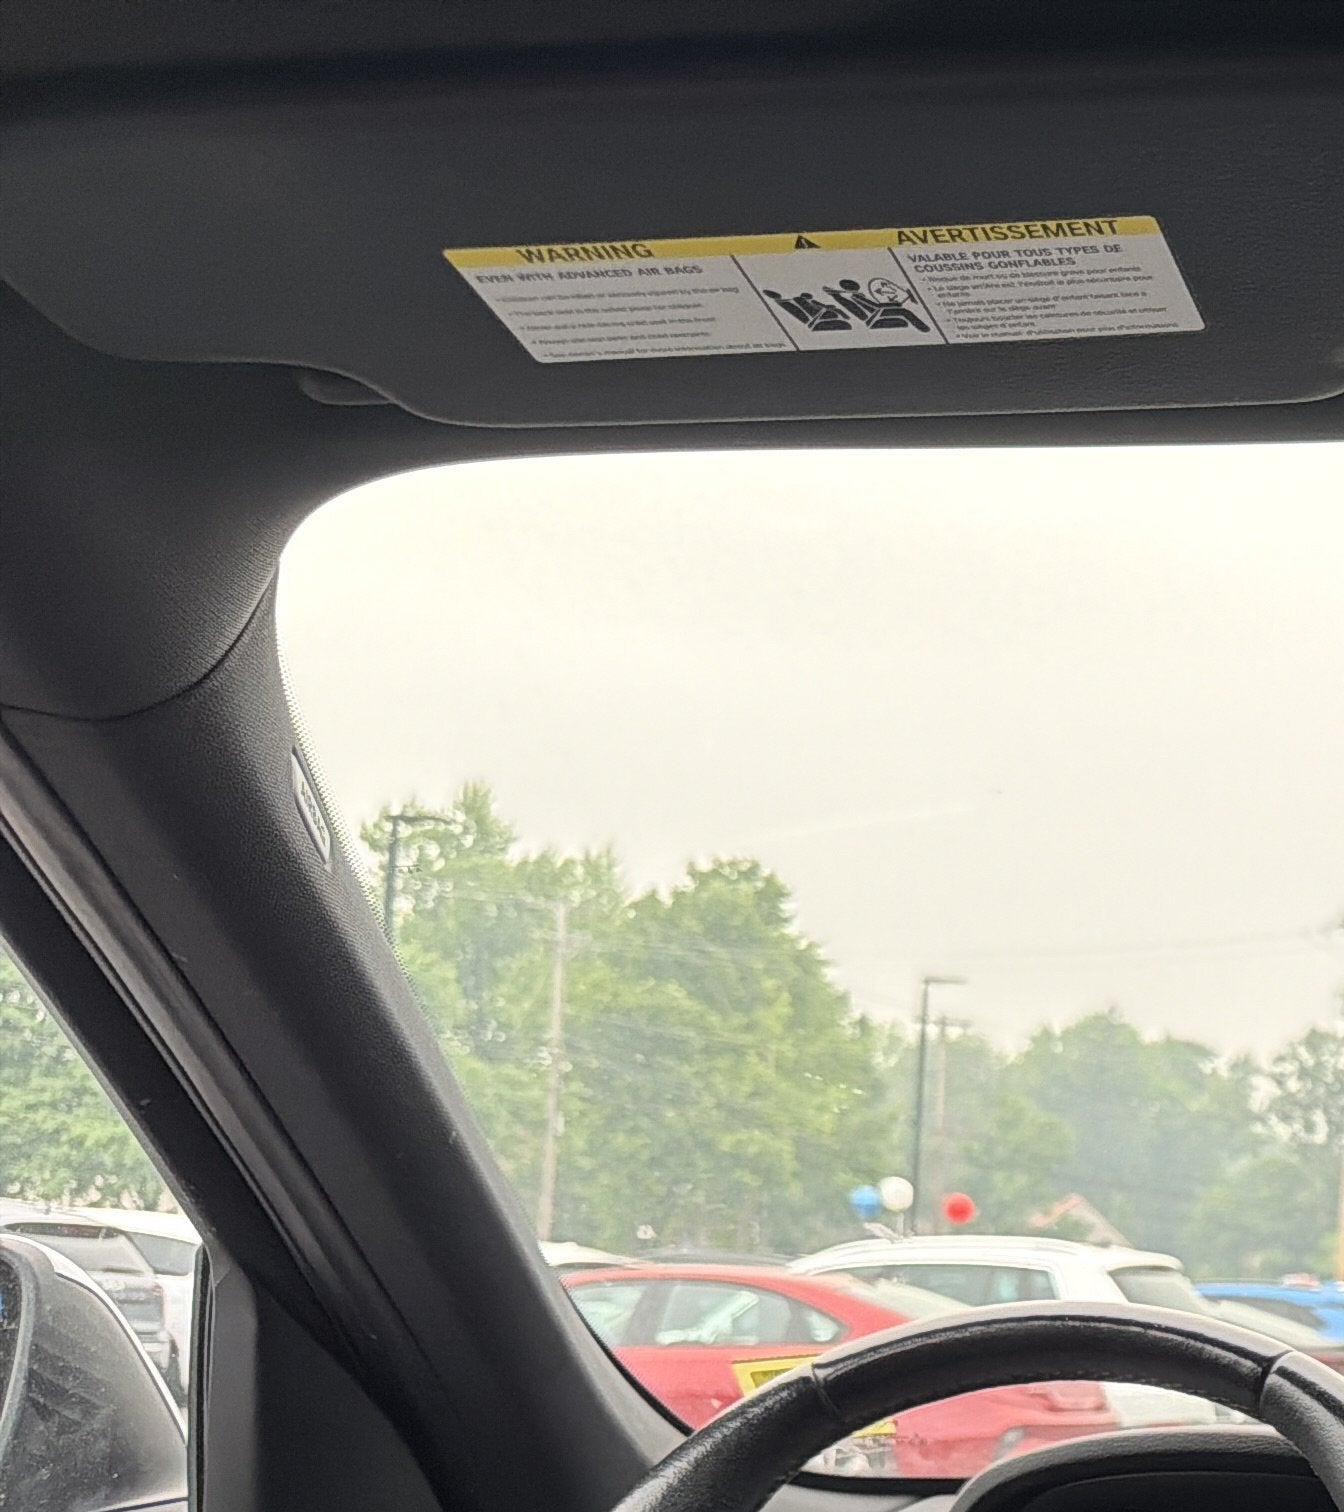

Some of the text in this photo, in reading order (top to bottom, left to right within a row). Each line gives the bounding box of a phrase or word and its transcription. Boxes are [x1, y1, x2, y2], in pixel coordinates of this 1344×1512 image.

[897, 220, 1118, 246] AVERTISSEMENT
[515, 243, 655, 264] WARNING
[907, 244, 1122, 263] VALABLE POUR TOUS TYPES DE
[475, 264, 703, 284] EVEN WITH ADVANCED AIR BAGS
[914, 257, 1076, 273] COUSSINS GONFLABLES
